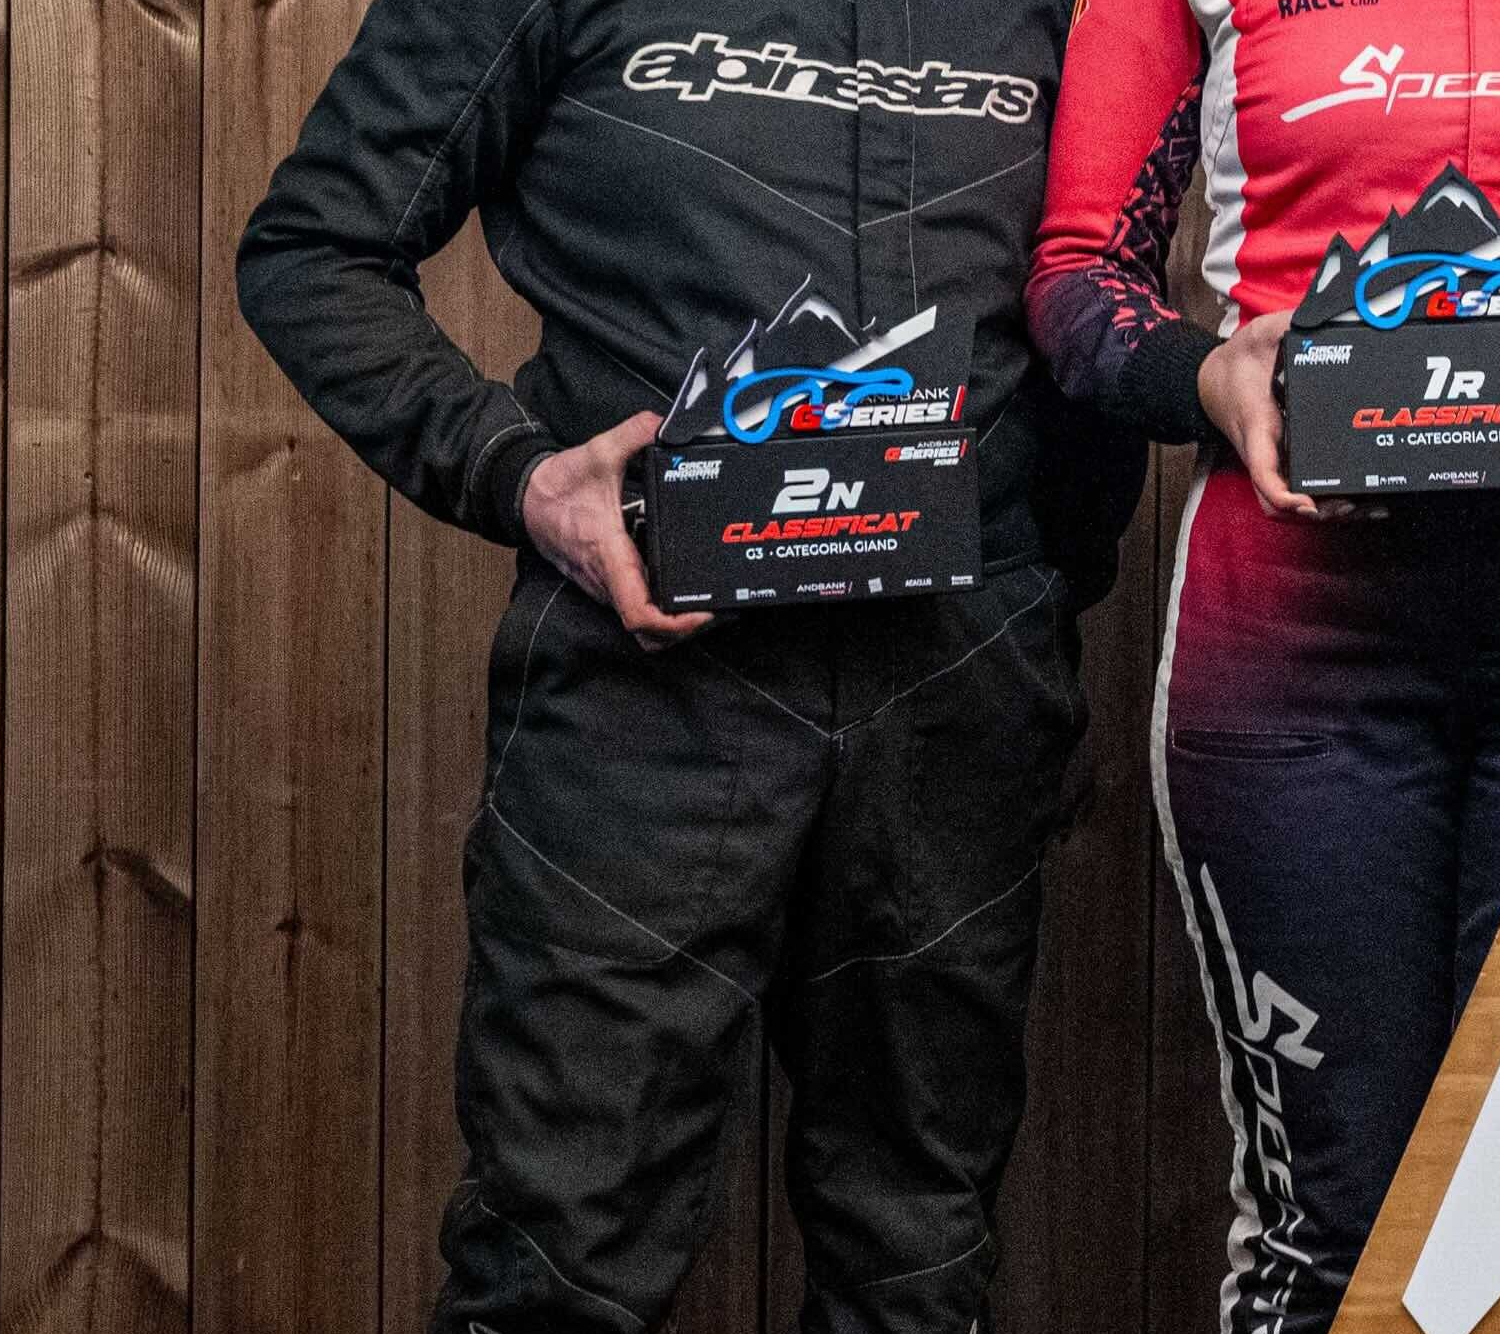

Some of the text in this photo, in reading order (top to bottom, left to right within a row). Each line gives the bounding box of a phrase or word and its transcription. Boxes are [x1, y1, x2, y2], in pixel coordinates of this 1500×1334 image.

[622, 33, 1038, 124] alpinestars
[1423, 356, 1486, 401] 1R
[790, 400, 951, 432] GSERIES
[1375, 433, 1395, 447] G3
[1406, 431, 1486, 446] CATEGORIA
[884, 445, 960, 462] GSERIES
[1428, 470, 1479, 482] ANDBANK
[771, 468, 865, 514] 2N
[721, 511, 920, 543] CLASSIFICAT
[745, 538, 898, 560] G3 CATEGORIA GIAND
[796, 581, 847, 594] ANDBANK
